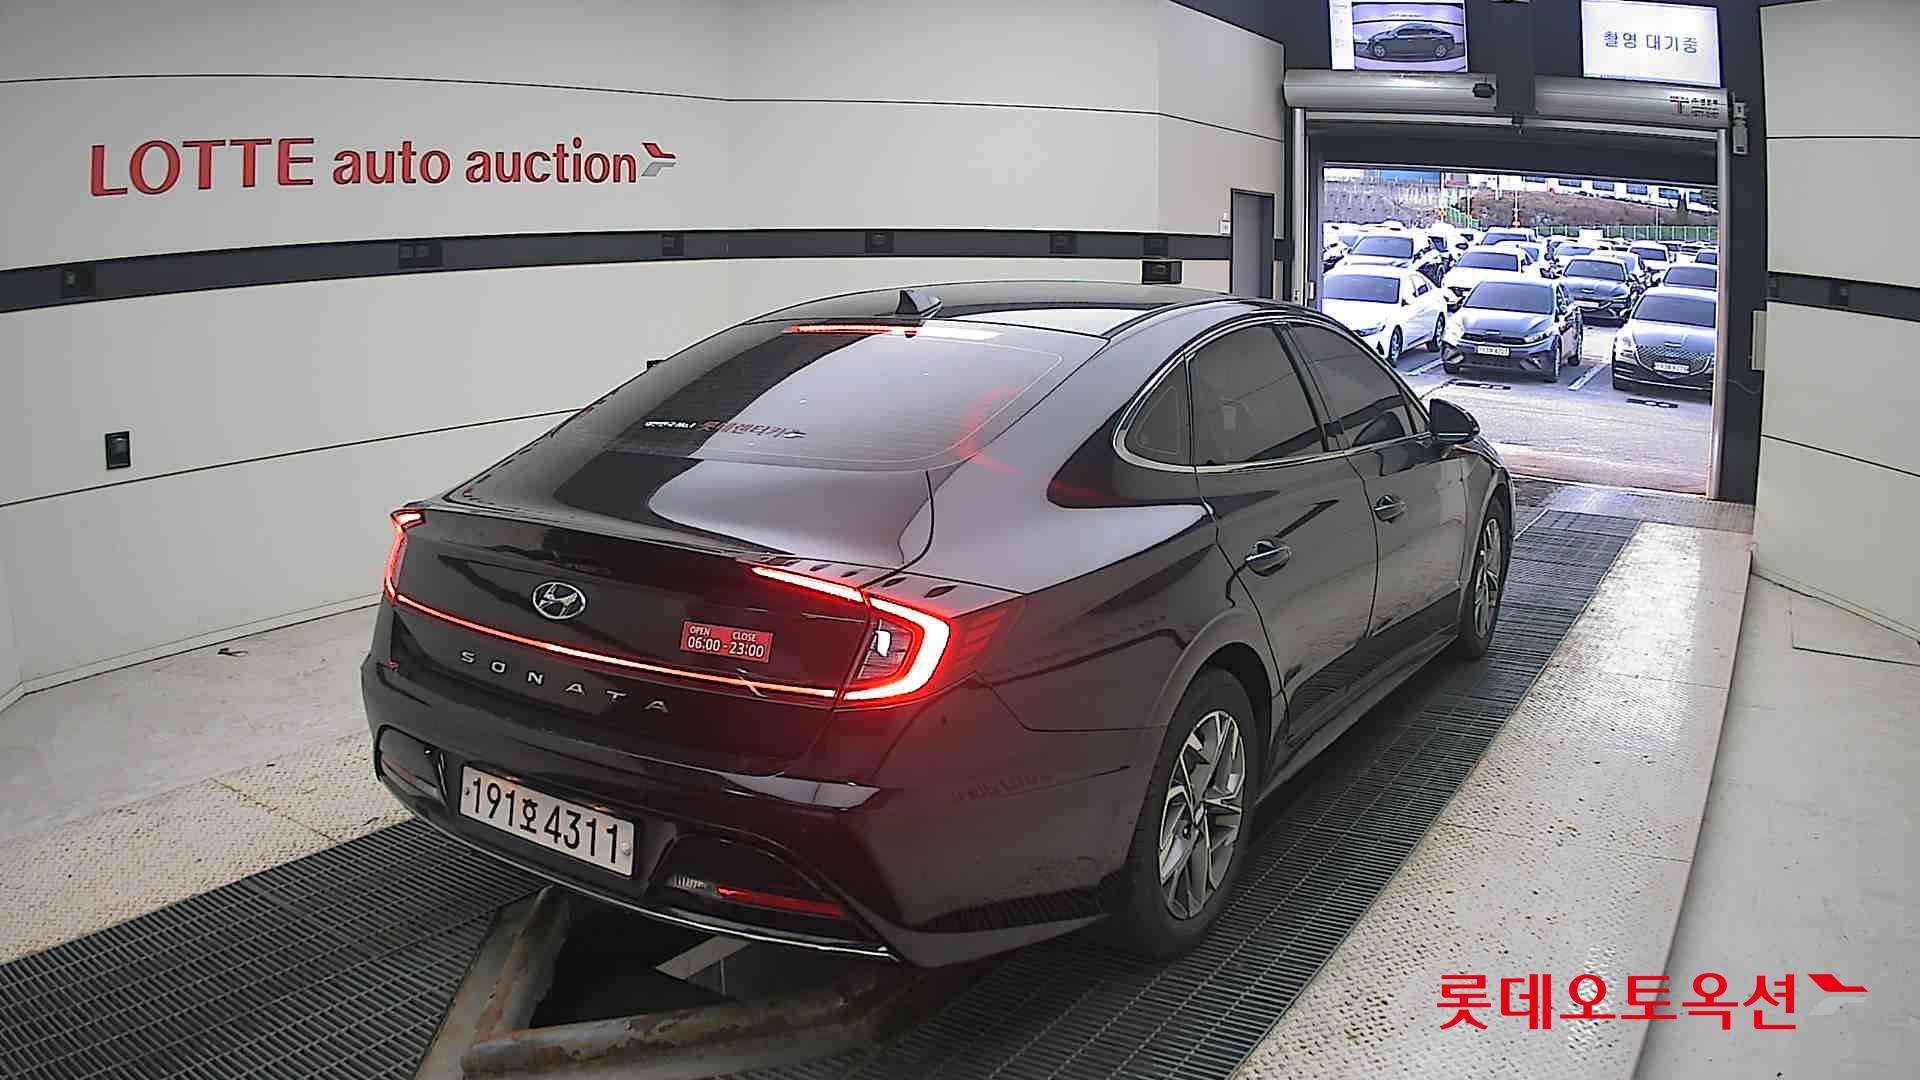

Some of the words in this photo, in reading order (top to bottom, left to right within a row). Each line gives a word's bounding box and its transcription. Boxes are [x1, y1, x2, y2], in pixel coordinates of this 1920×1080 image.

[1603, 31, 1637, 49] 촬영
[1645, 34, 1698, 54] 대기중
[90, 137, 315, 197] LOTTE
[332, 140, 451, 185] auto
[464, 136, 638, 184] auction
[689, 626, 711, 637] OPEN
[732, 631, 757, 642] CLOSE
[687, 636, 721, 652] 06:00
[728, 641, 765, 658] 23:00
[460, 651, 670, 713] SONATA
